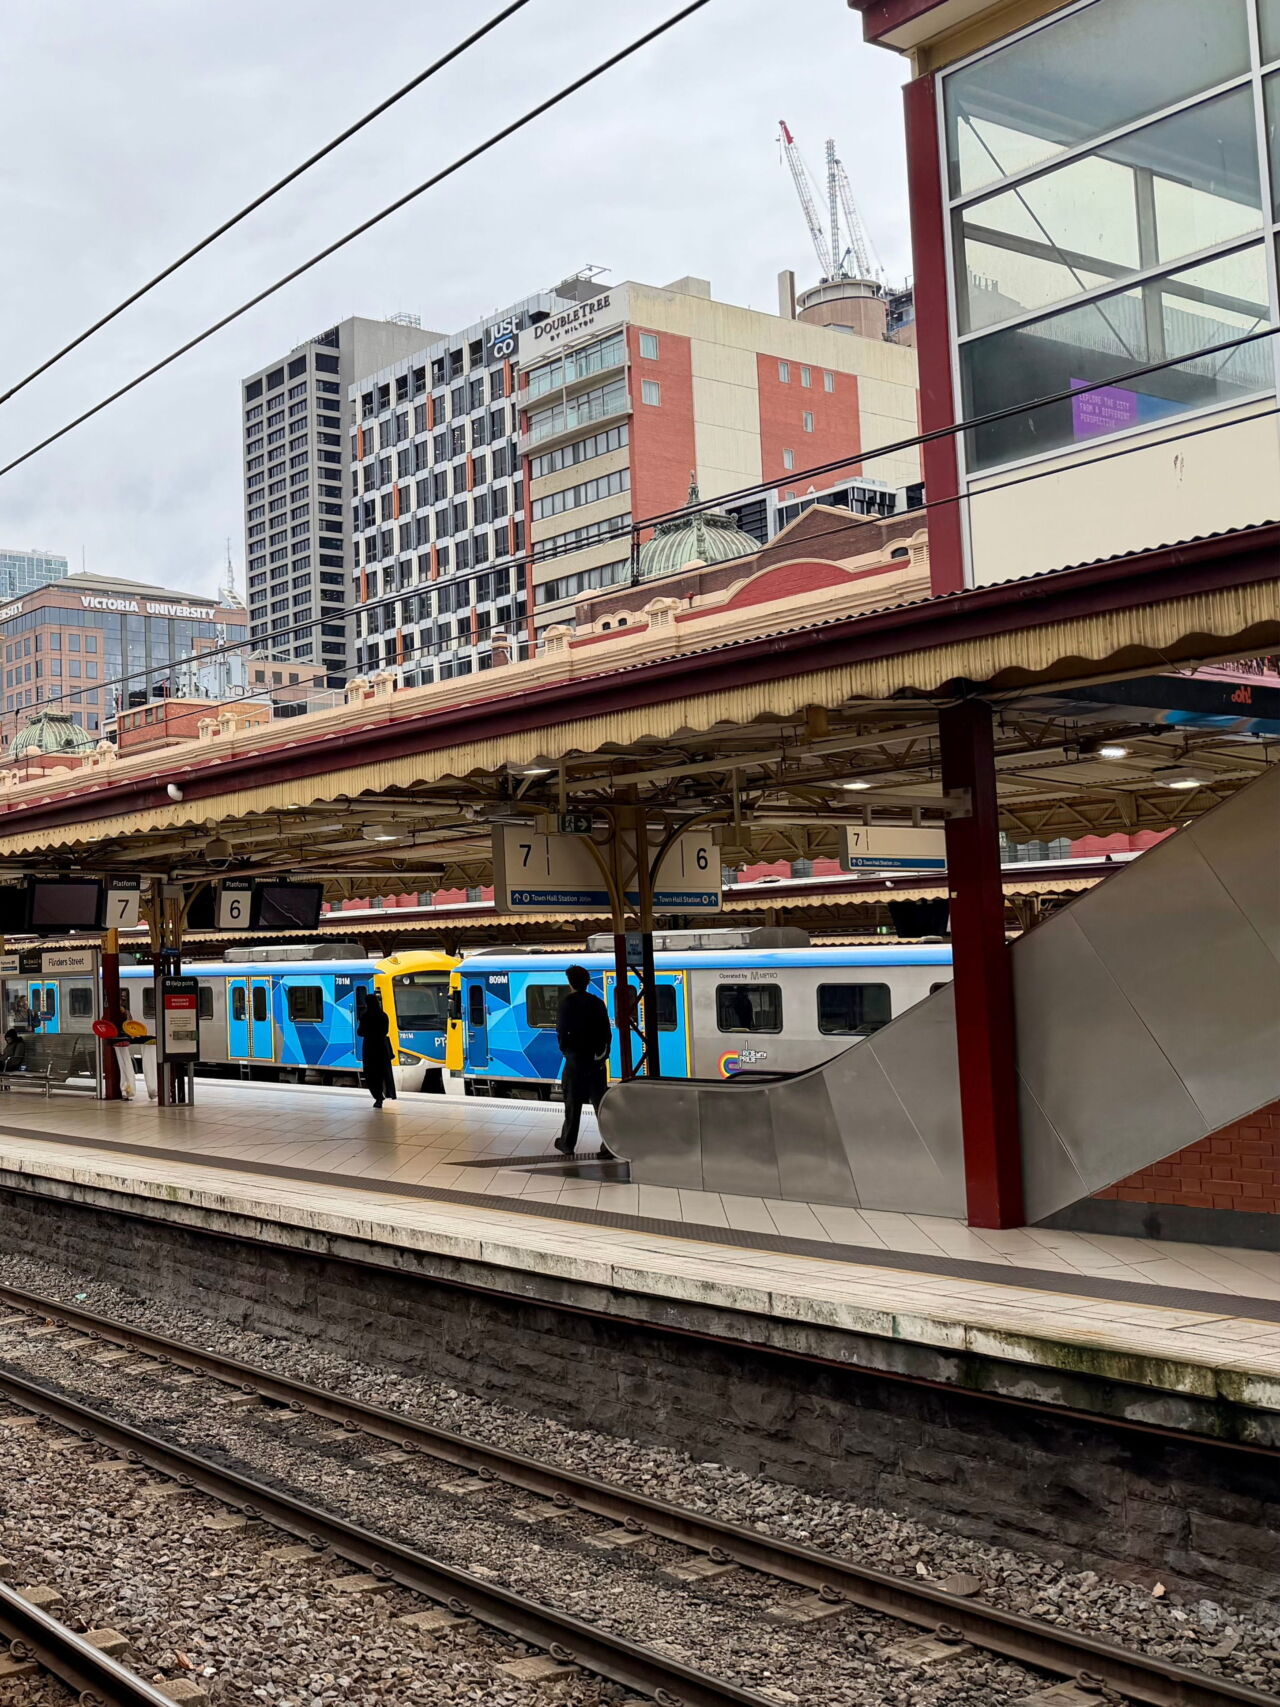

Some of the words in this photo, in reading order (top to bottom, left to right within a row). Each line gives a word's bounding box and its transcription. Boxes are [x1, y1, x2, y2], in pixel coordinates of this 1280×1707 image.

[534, 295, 611, 339] DOUBLETREE
[550, 333, 560, 341] BY
[565, 317, 594, 335] HILTON
[1080, 402, 1094, 413] FROM
[1102, 407, 1130, 420] DIFFERENT
[1104, 397, 1114, 407] THE
[1117, 401, 1130, 410] CITY
[81, 596, 139, 612] VICTORIA
[146, 603, 216, 620] UNIVERSITY
[853, 832, 860, 846] 7
[519, 844, 532, 867] 7
[696, 848, 708, 870] 6
[547, 894, 557, 902] Hall
[118, 899, 129, 919] 7
[230, 899, 241, 919] 6
[48, 958, 67, 966] Flinders
[68, 957, 84, 966] Street
[336, 977, 350, 985] 781M
[489, 975, 508, 984] 809M
[434, 1036, 447, 1047] PT
